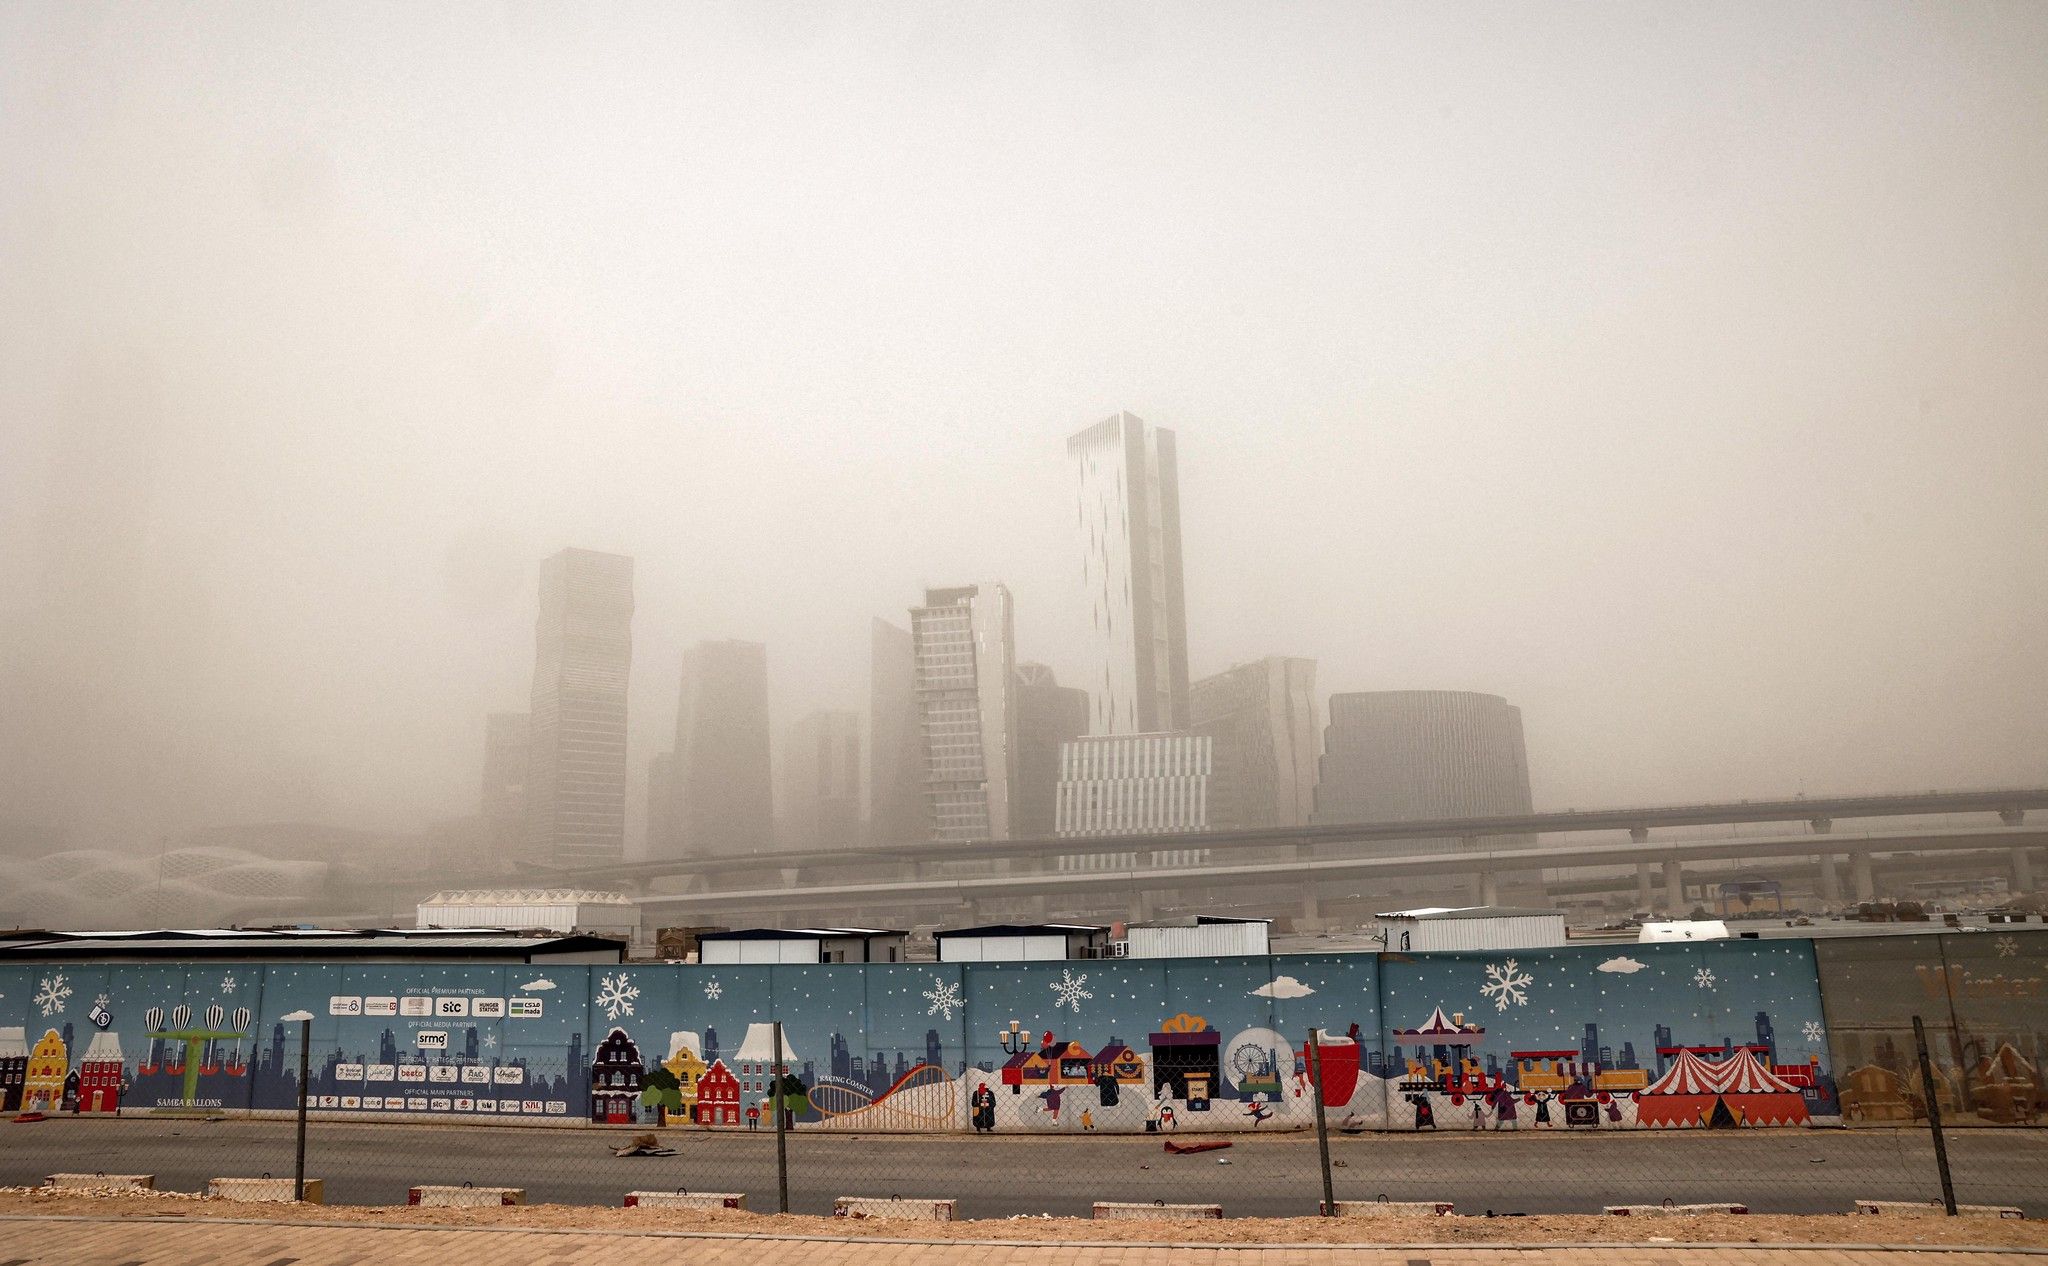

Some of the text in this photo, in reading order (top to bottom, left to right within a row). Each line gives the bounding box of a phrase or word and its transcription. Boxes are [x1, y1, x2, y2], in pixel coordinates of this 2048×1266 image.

[406, 987, 430, 995] OFFICIAL
[432, 987, 457, 995] PREMIUM
[442, 1001, 462, 1013] stc
[453, 1021, 477, 1029] PARTNER
[419, 1033, 447, 1046] srmg
[819, 1075, 874, 1096] RACING COASTER
[446, 1089, 474, 1097] PARTNERS
[156, 1098, 223, 1107] SAMBA BALLONS
